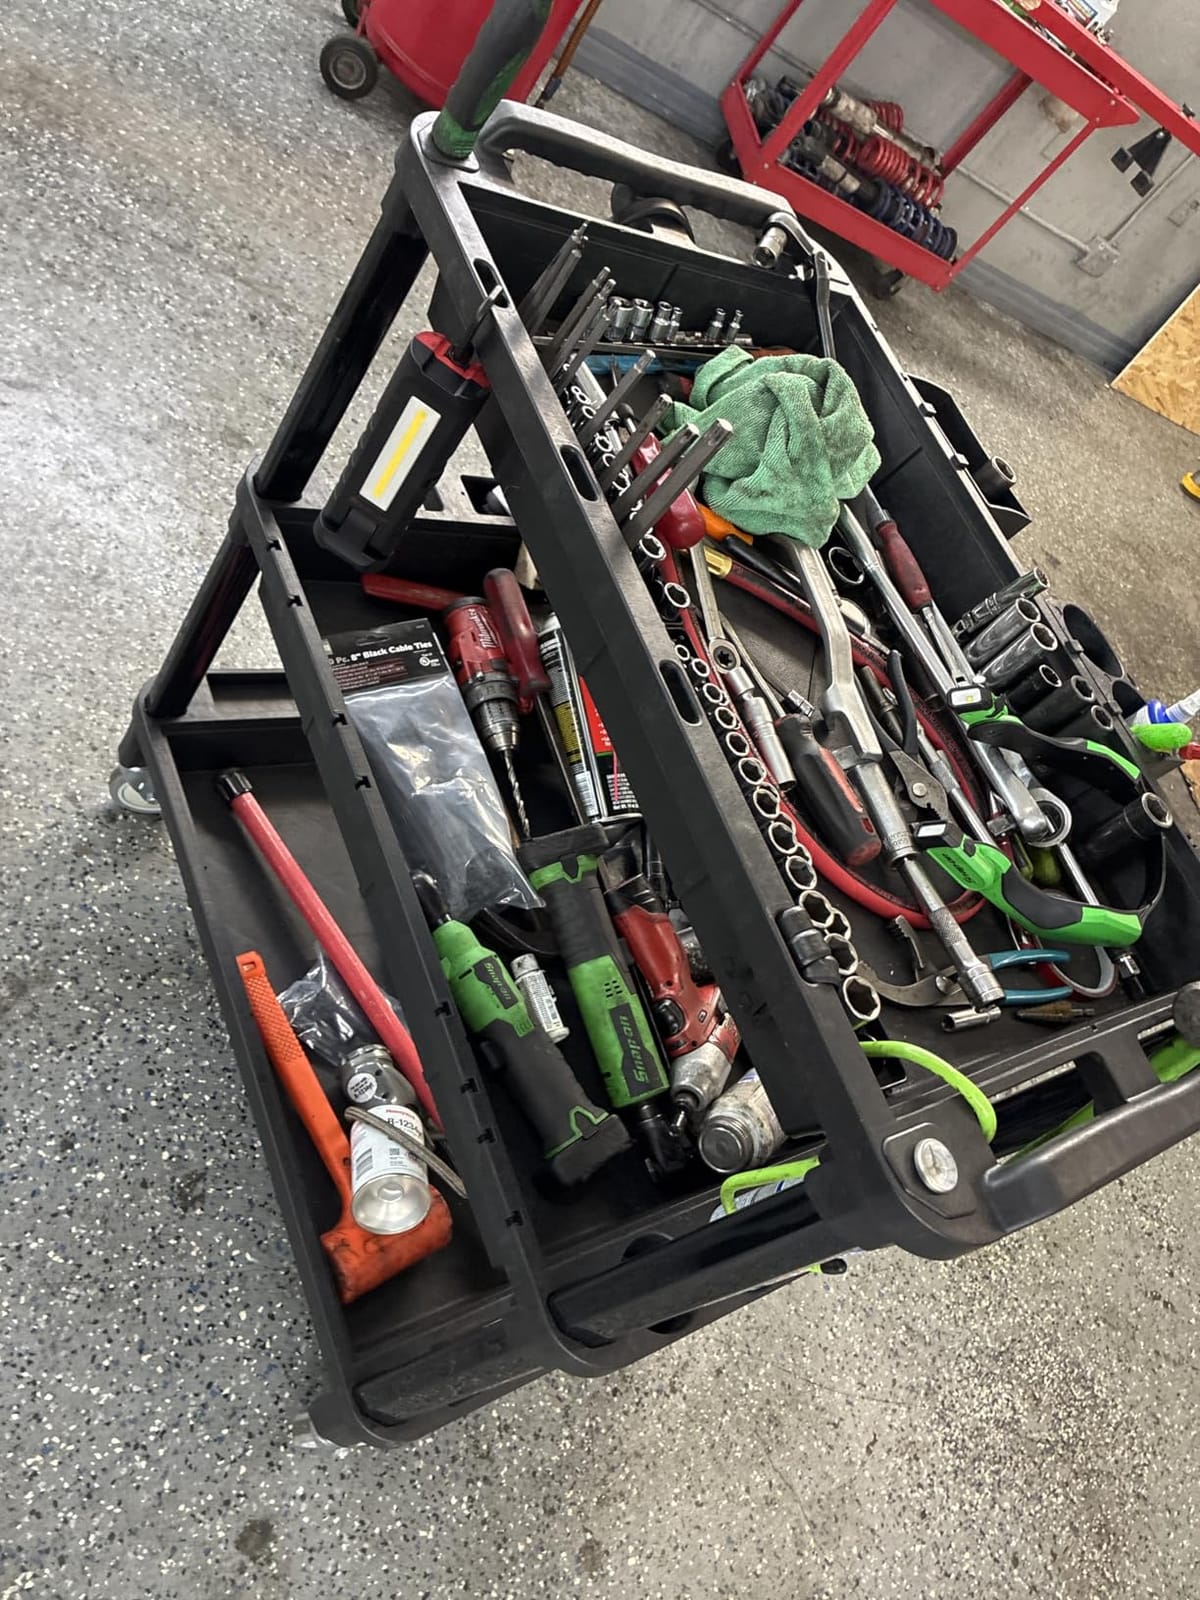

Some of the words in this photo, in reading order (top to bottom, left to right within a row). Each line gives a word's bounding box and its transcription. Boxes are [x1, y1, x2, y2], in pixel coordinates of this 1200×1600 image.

[362, 648, 388, 658] Black
[388, 643, 414, 653] Cable
[413, 641, 433, 650] Ties
